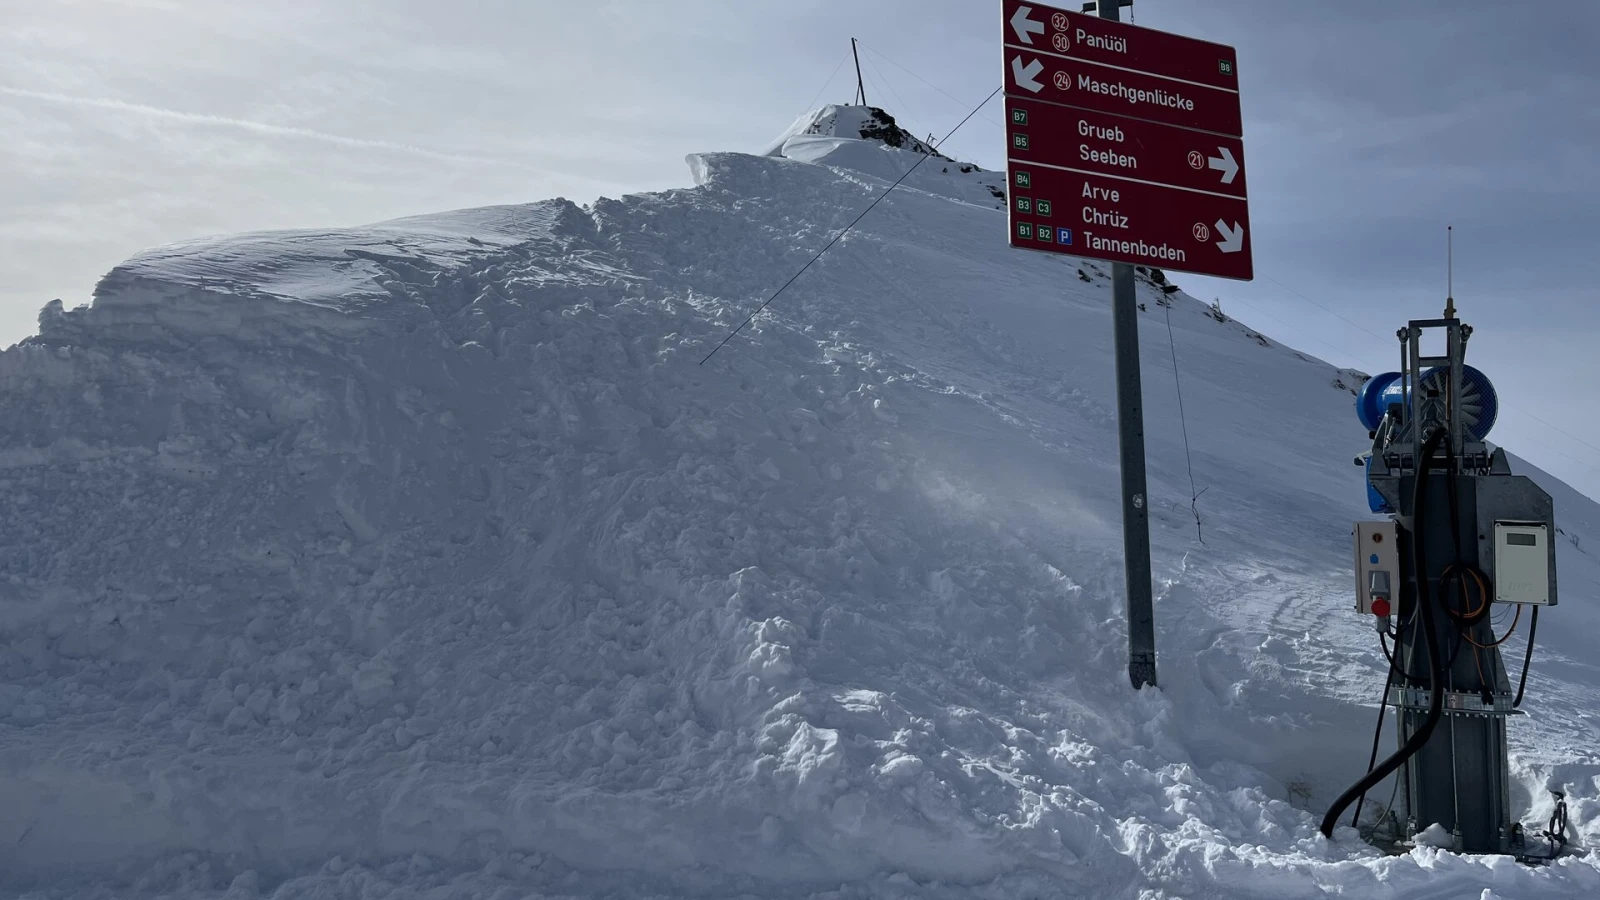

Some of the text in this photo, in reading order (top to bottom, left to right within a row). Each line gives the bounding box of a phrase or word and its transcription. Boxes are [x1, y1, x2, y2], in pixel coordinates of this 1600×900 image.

[1053, 15, 1067, 30] 32
[1054, 35, 1068, 50] 30
[1076, 28, 1127, 53] Panüöl
[1220, 62, 1231, 73] B8
[1056, 73, 1069, 88] 24
[1078, 74, 1194, 111] Maschgenlücke
[1014, 112, 1026, 122] B7
[1078, 120, 1125, 142] Grueb
[1015, 136, 1027, 147] B5
[1079, 145, 1137, 168] Seeben
[1190, 153, 1202, 167] 21
[1017, 174, 1028, 185] B4
[1082, 182, 1120, 202] Arve
[1018, 200, 1030, 210] B3
[1038, 202, 1050, 213] C3
[1082, 206, 1129, 229] Chrüz
[1019, 225, 1031, 236] B1
[1039, 228, 1051, 239] B2
[1060, 230, 1069, 242] P
[1195, 225, 1208, 239] 20
[1084, 231, 1186, 262] Tannenboden
